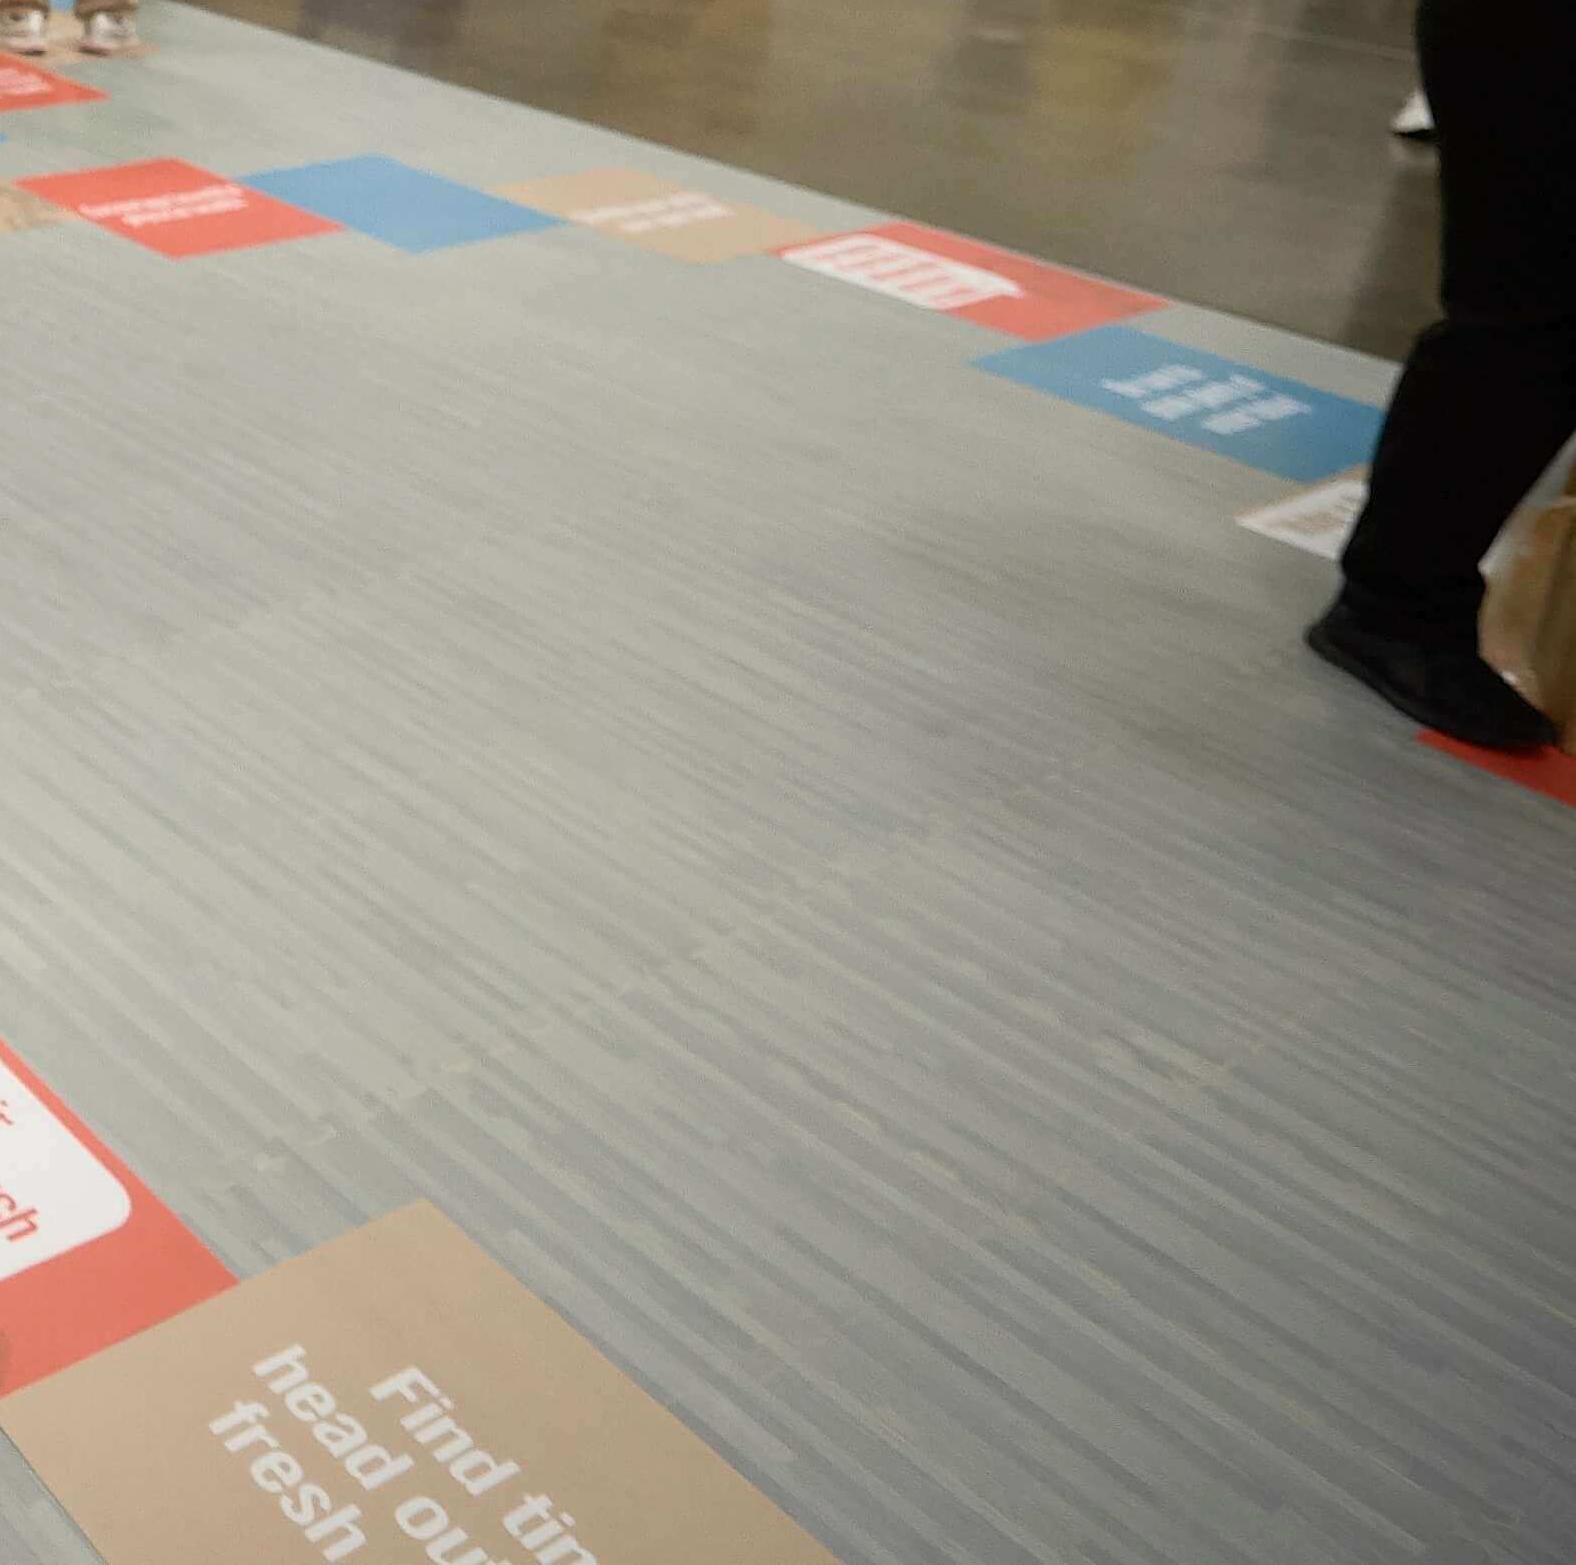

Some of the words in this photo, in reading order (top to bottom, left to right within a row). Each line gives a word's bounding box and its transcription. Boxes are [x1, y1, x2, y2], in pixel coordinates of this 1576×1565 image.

[208, 1399, 368, 1563] fresh
[251, 1343, 415, 1491] head
[368, 1365, 521, 1497] Find
